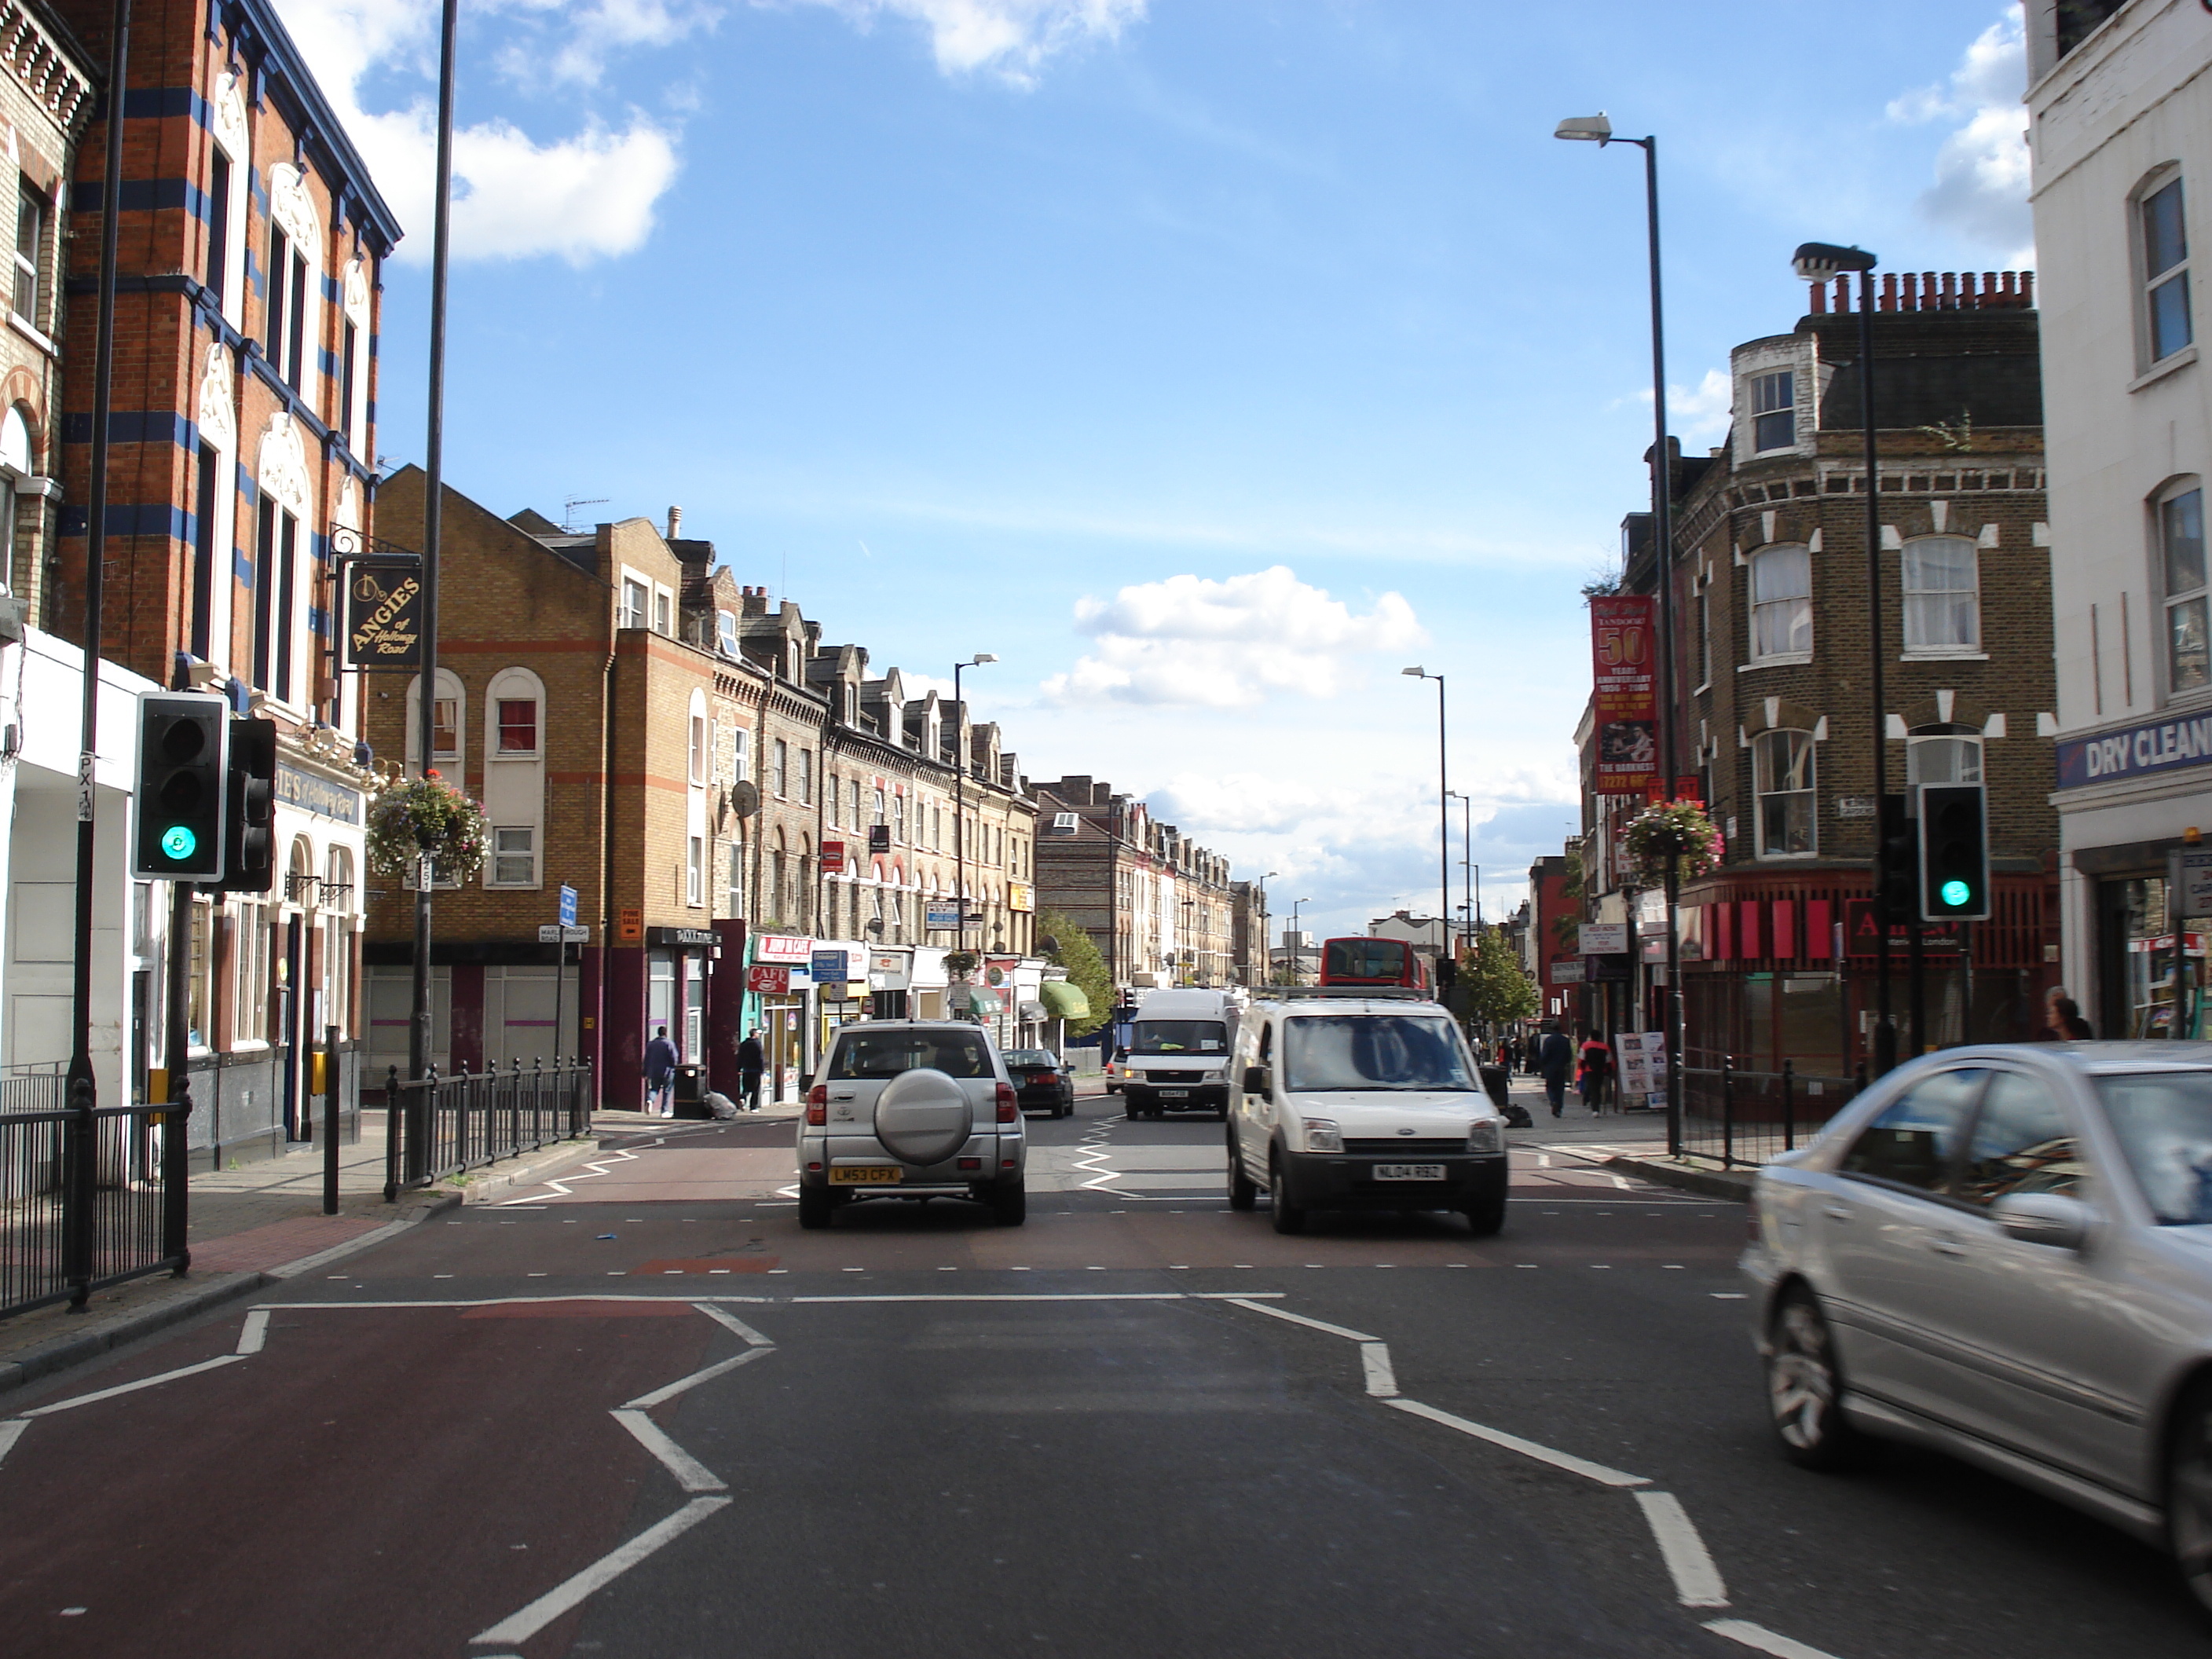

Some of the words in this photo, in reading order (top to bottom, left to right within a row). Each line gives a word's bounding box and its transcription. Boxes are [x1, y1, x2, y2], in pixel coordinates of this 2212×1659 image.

[352, 577, 419, 652] ANGIES
[394, 618, 410, 631] of
[374, 630, 417, 644] Holloway
[377, 643, 408, 654] Road
[1598, 626, 1646, 665] 50
[2086, 734, 2130, 778] DRY
[2133, 716, 2212, 767] CLEAN
[767, 938, 786, 953] JUMP
[793, 939, 809, 954] CAFE
[749, 966, 789, 984] CAFE
[870, 1169, 895, 1181] CFX
